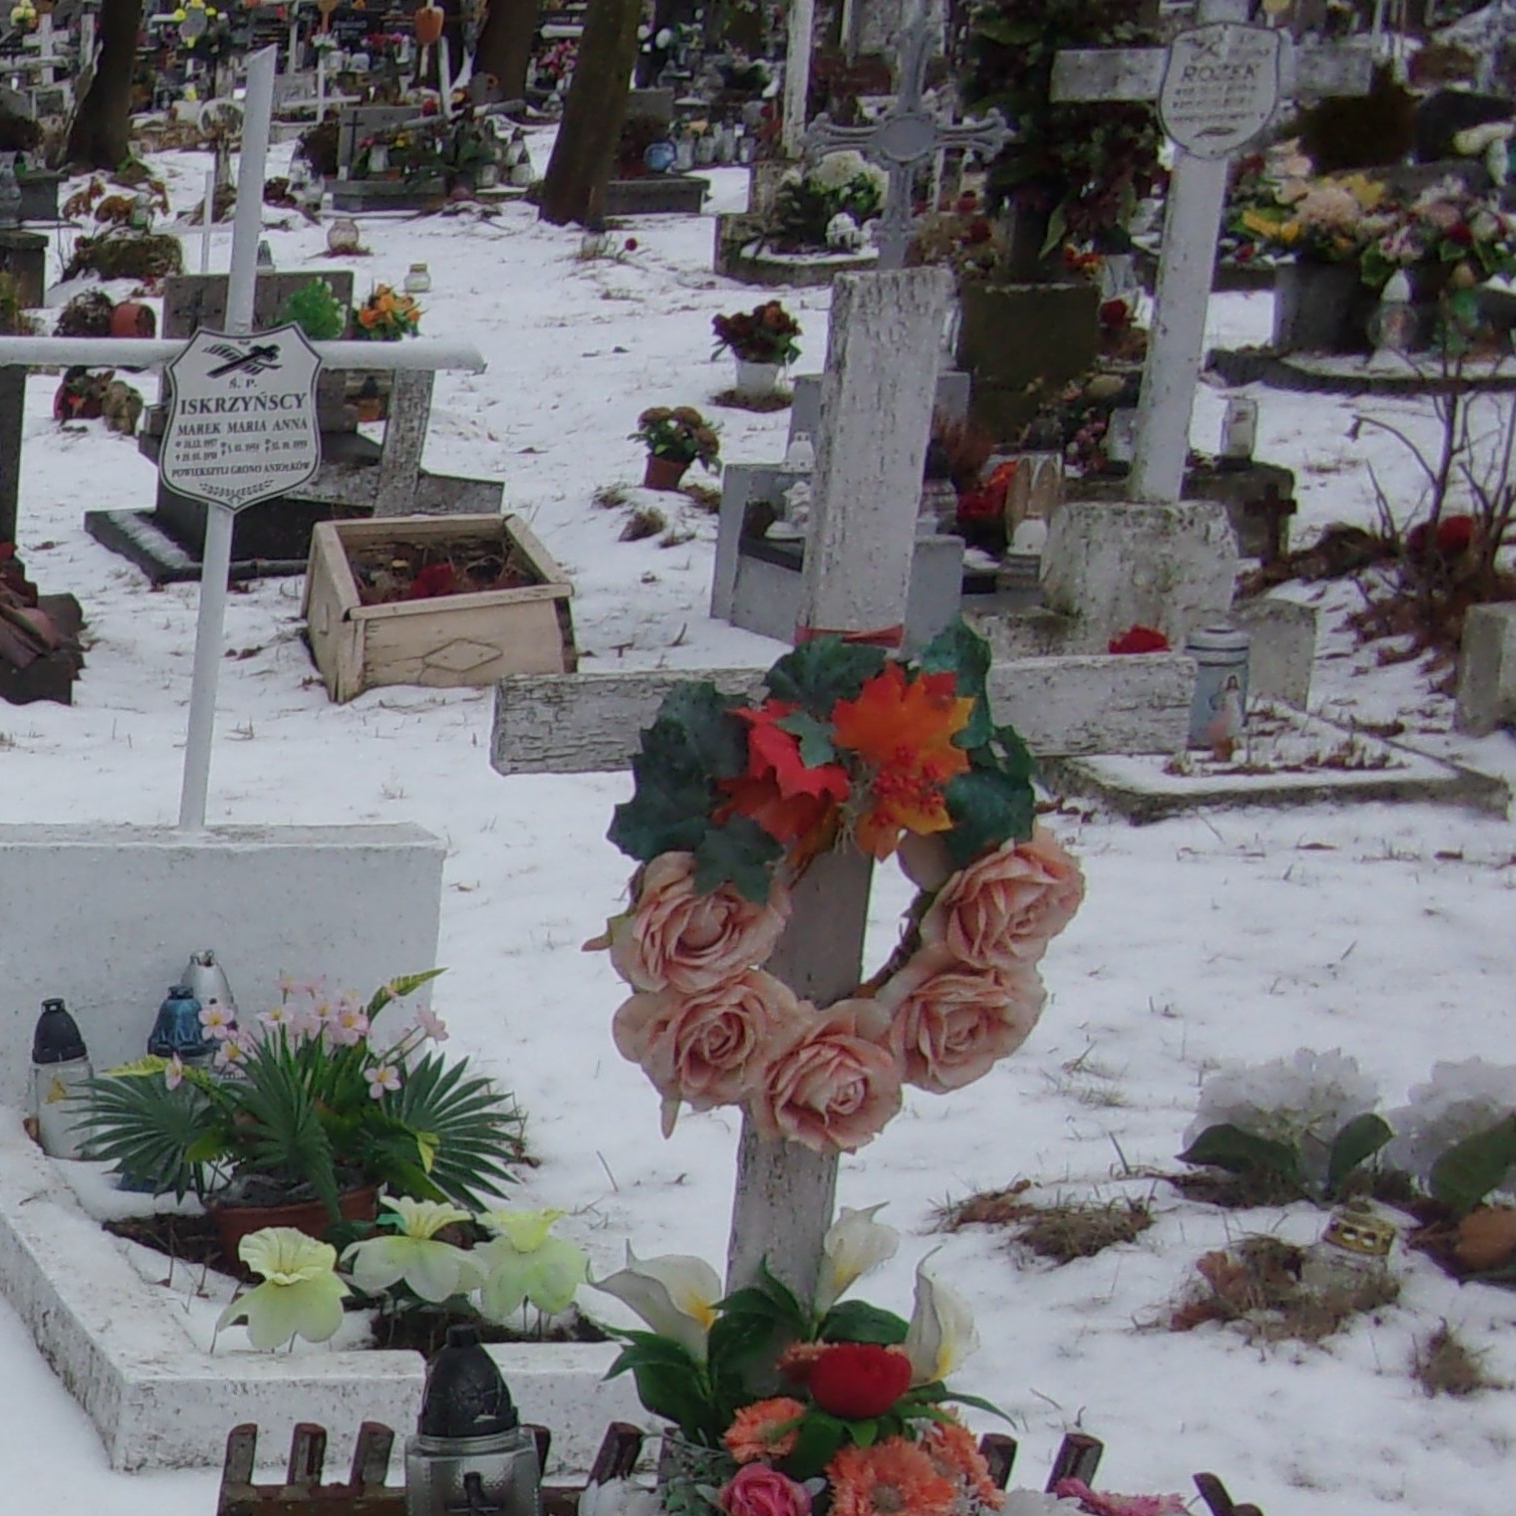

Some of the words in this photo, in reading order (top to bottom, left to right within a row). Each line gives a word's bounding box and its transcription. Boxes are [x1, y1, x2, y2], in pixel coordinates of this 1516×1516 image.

[180, 391, 308, 416] ISKRZYŃSCY
[177, 422, 221, 437] MAREK
[227, 419, 267, 436] MARIA
[272, 417, 308, 432] ANNA
